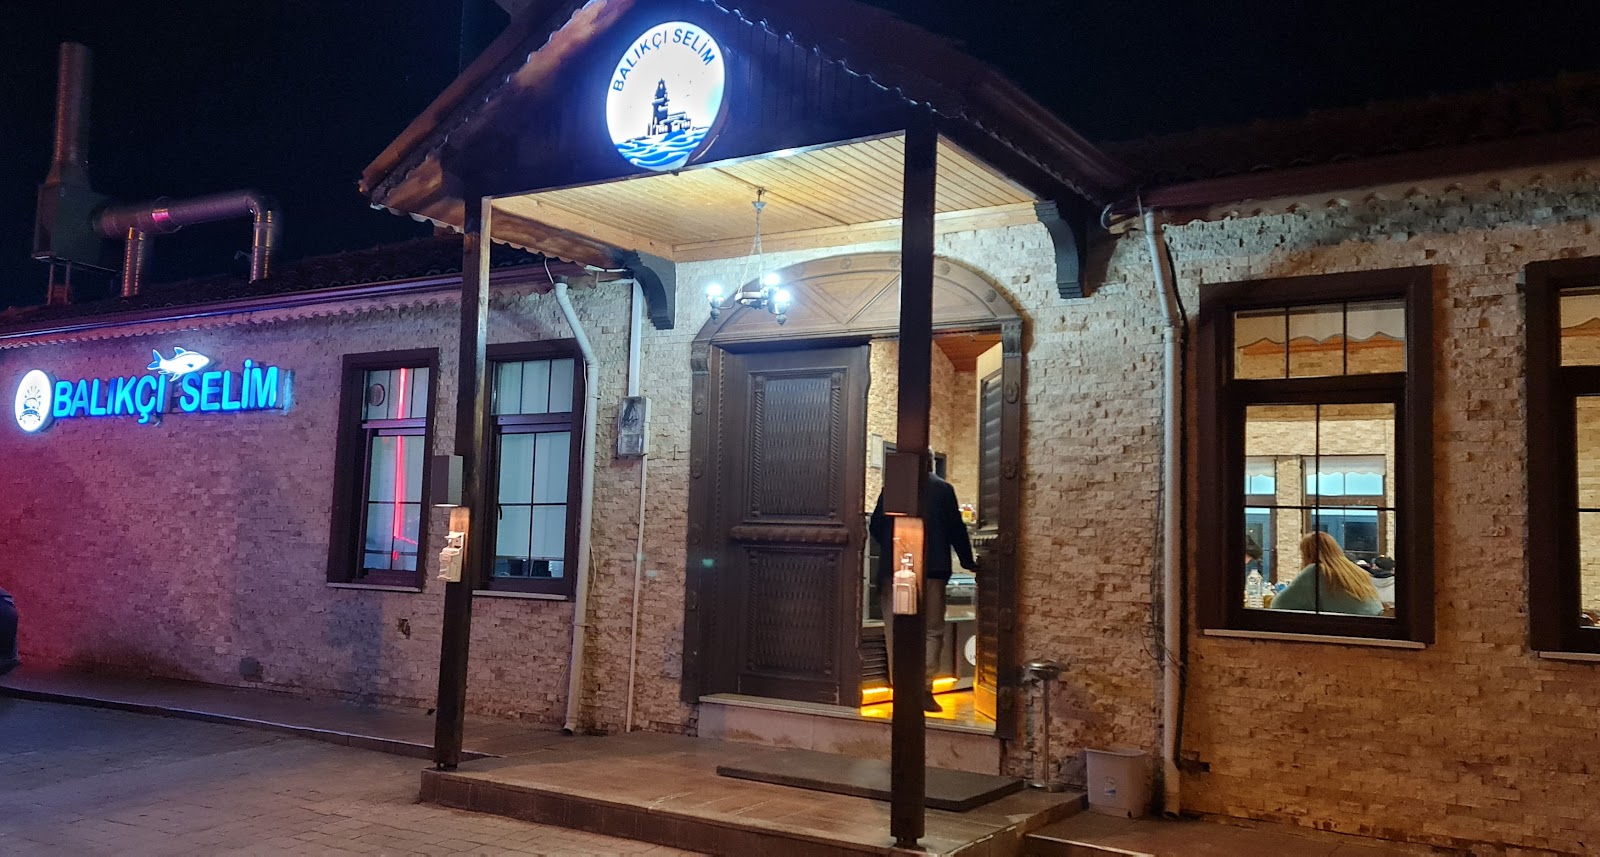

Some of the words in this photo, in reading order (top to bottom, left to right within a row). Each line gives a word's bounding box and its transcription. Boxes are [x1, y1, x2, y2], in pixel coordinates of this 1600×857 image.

[613, 31, 667, 91] BALIKÇI
[673, 28, 715, 65] SELİM
[53, 374, 166, 423] BALIKÇI
[180, 359, 278, 411] SELİM
